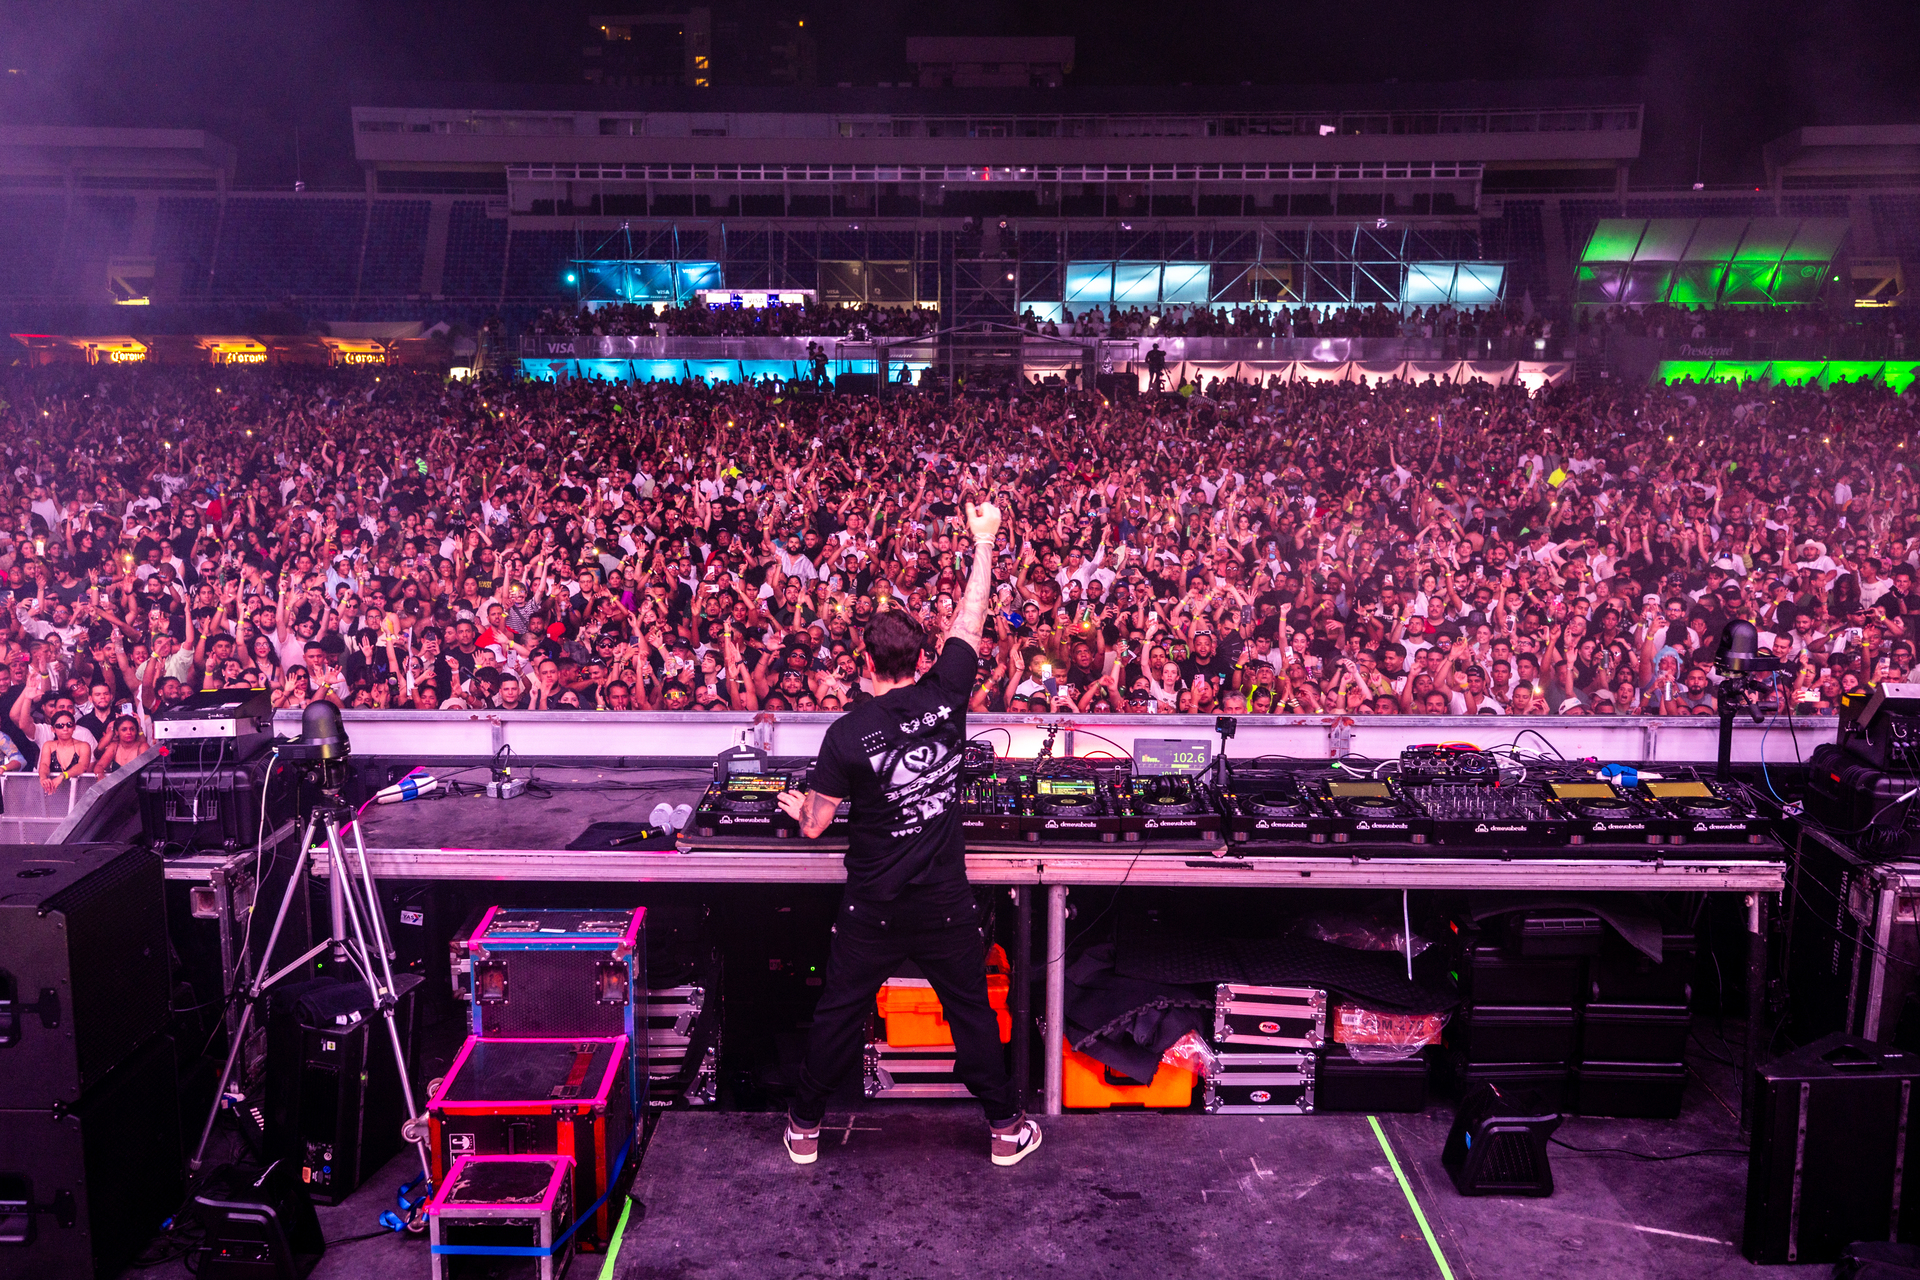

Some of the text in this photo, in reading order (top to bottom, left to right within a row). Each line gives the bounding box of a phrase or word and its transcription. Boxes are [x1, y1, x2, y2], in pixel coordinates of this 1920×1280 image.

[547, 343, 575, 354] VISA
[1679, 344, 1733, 356] Presidente
[1173, 752, 1205, 763] 102.6
[1060, 820, 1097, 828] denovabeats
[1160, 820, 1197, 828] denovabeats
[1271, 820, 1308, 829] denovabeats
[1371, 821, 1409, 830] denovabeats
[1607, 823, 1645, 831] denovabeats
[1708, 823, 1746, 831] denovabeats
